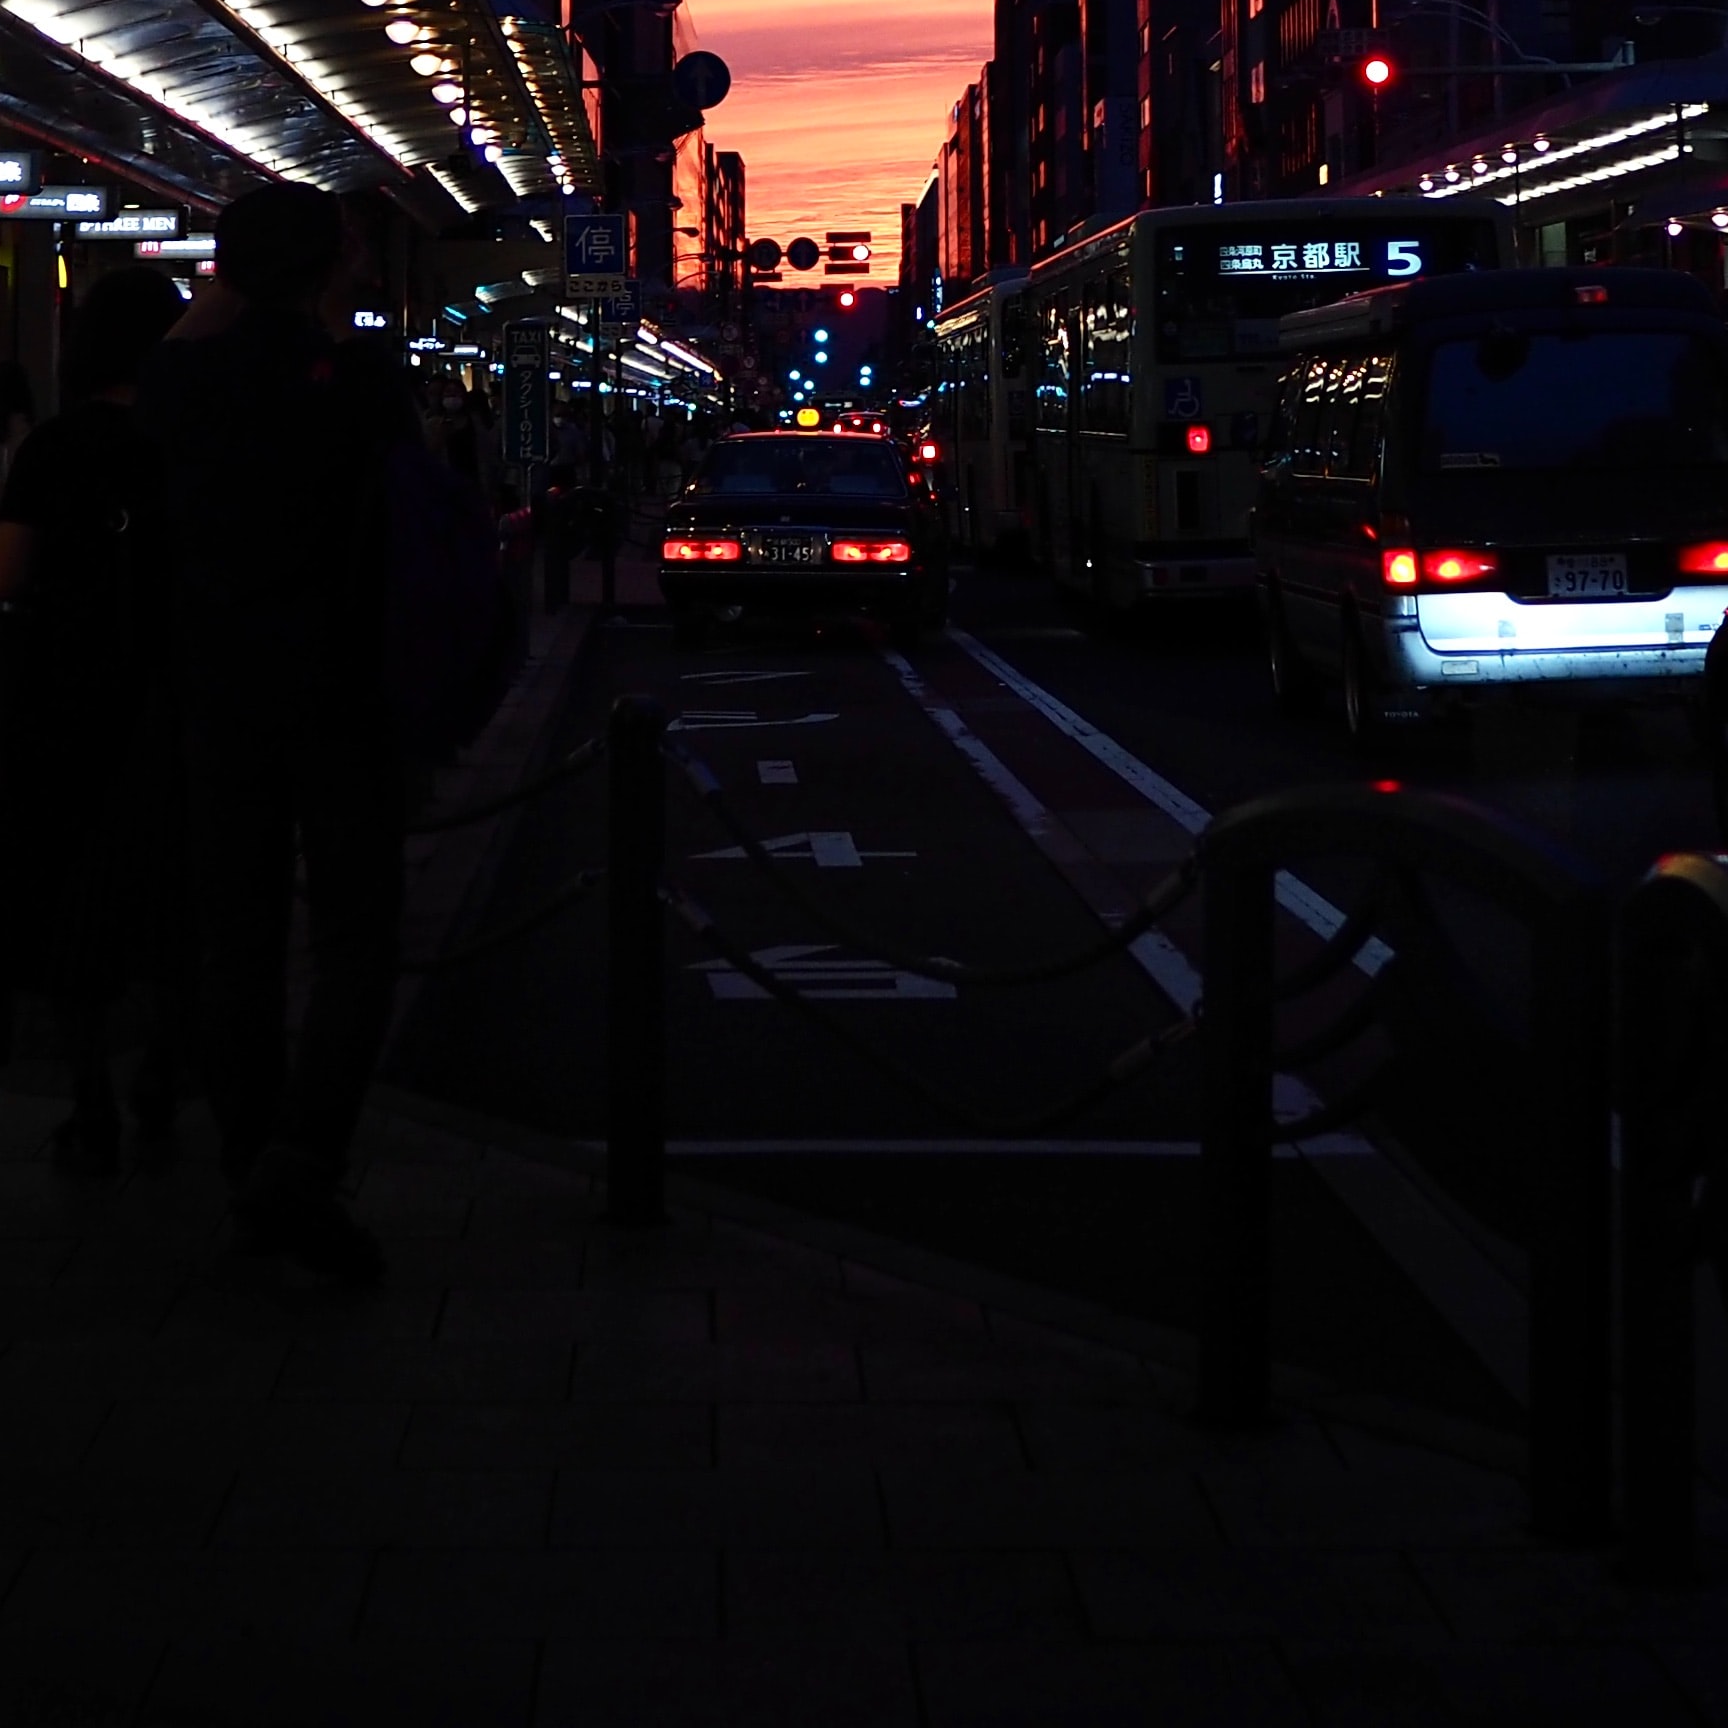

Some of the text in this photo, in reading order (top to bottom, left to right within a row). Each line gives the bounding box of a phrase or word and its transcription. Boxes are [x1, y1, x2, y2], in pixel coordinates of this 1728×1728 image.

[574, 224, 616, 265] 停
[1270, 241, 1362, 270] 京都駅
[1386, 240, 1423, 277] 5
[569, 280, 622, 293] ここから
[511, 330, 542, 345] TAXI
[1564, 570, 1624, 592] 97-70
